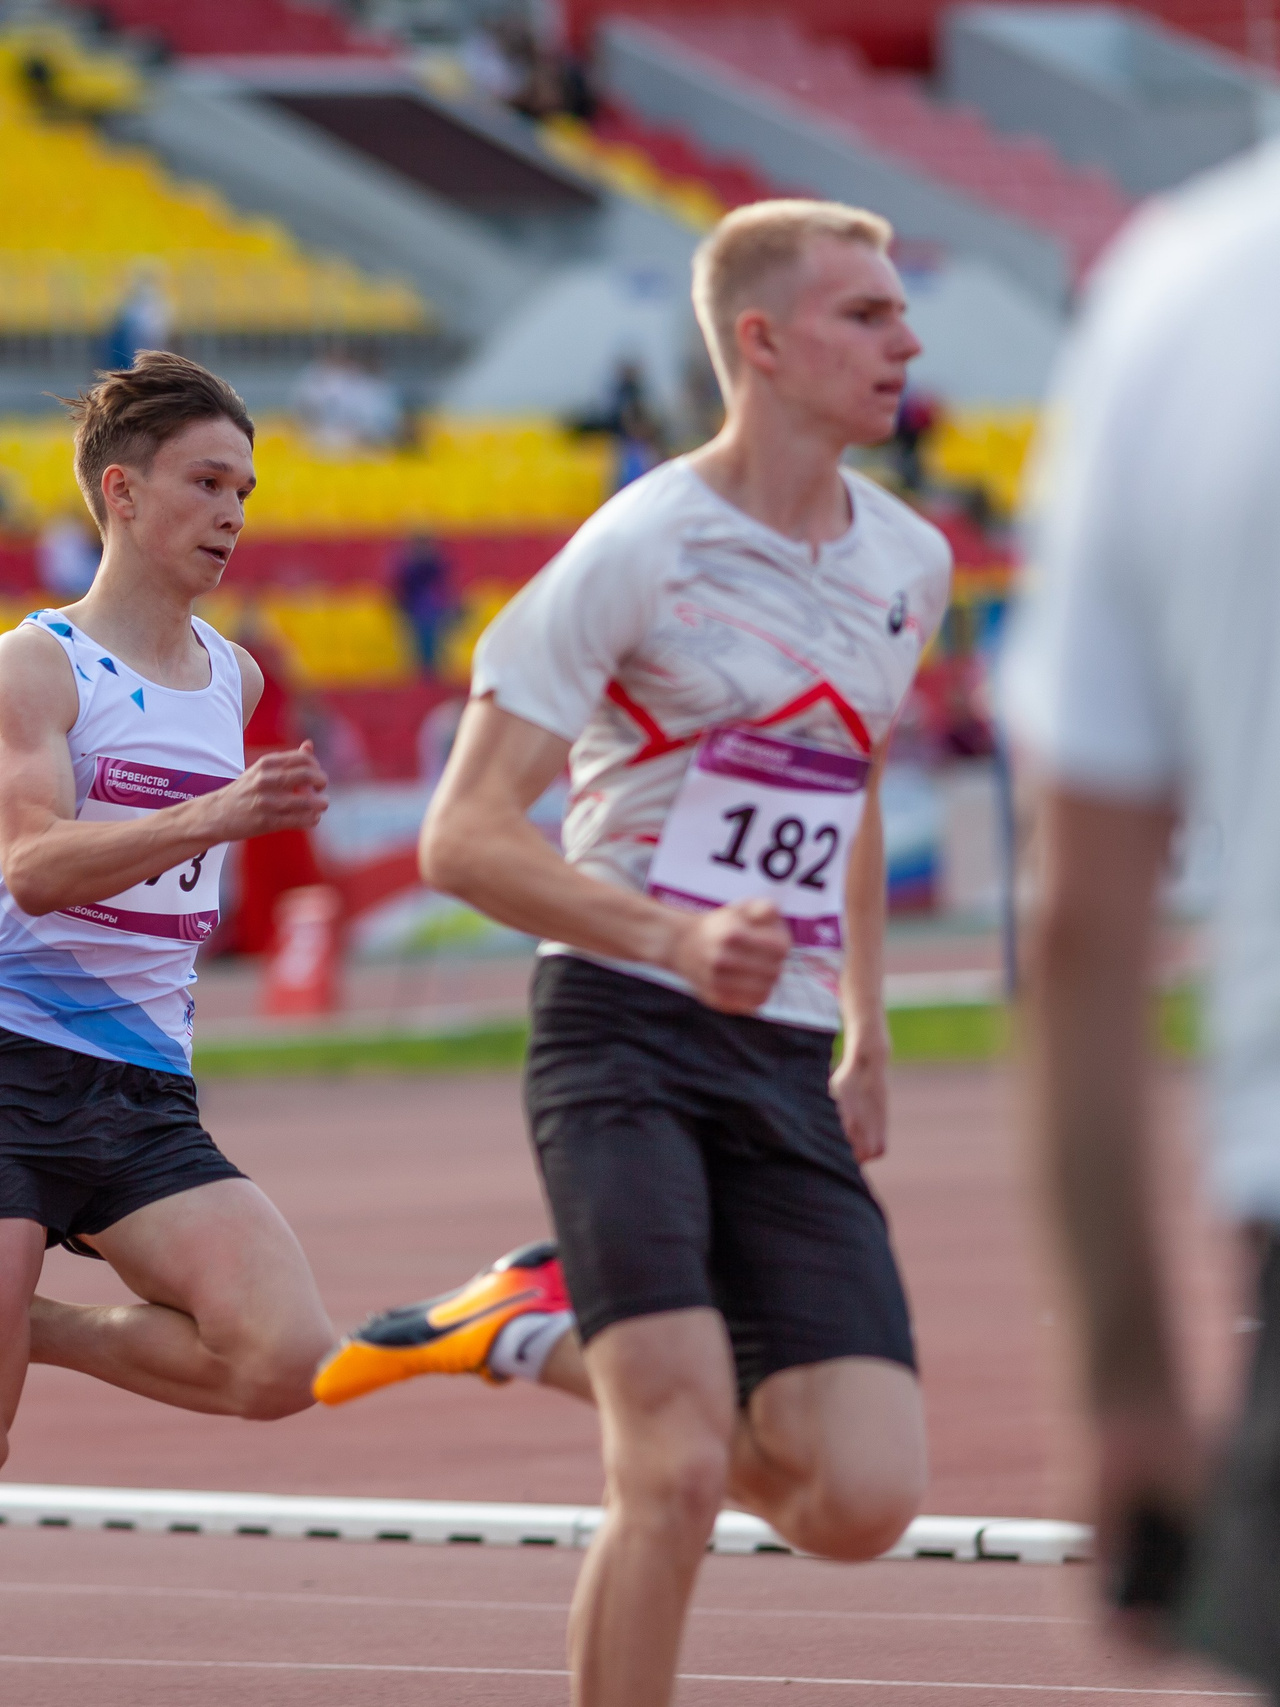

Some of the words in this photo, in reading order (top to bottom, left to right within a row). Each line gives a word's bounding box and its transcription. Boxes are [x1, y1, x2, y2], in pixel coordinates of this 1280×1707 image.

[108, 768, 169, 787] ПЕРВЕНСТВО
[106, 779, 163, 796] ПРИВОЛЖСКОГО
[710, 804, 839, 891] 182
[66, 906, 118, 923] ЕБОКСАРЫ
